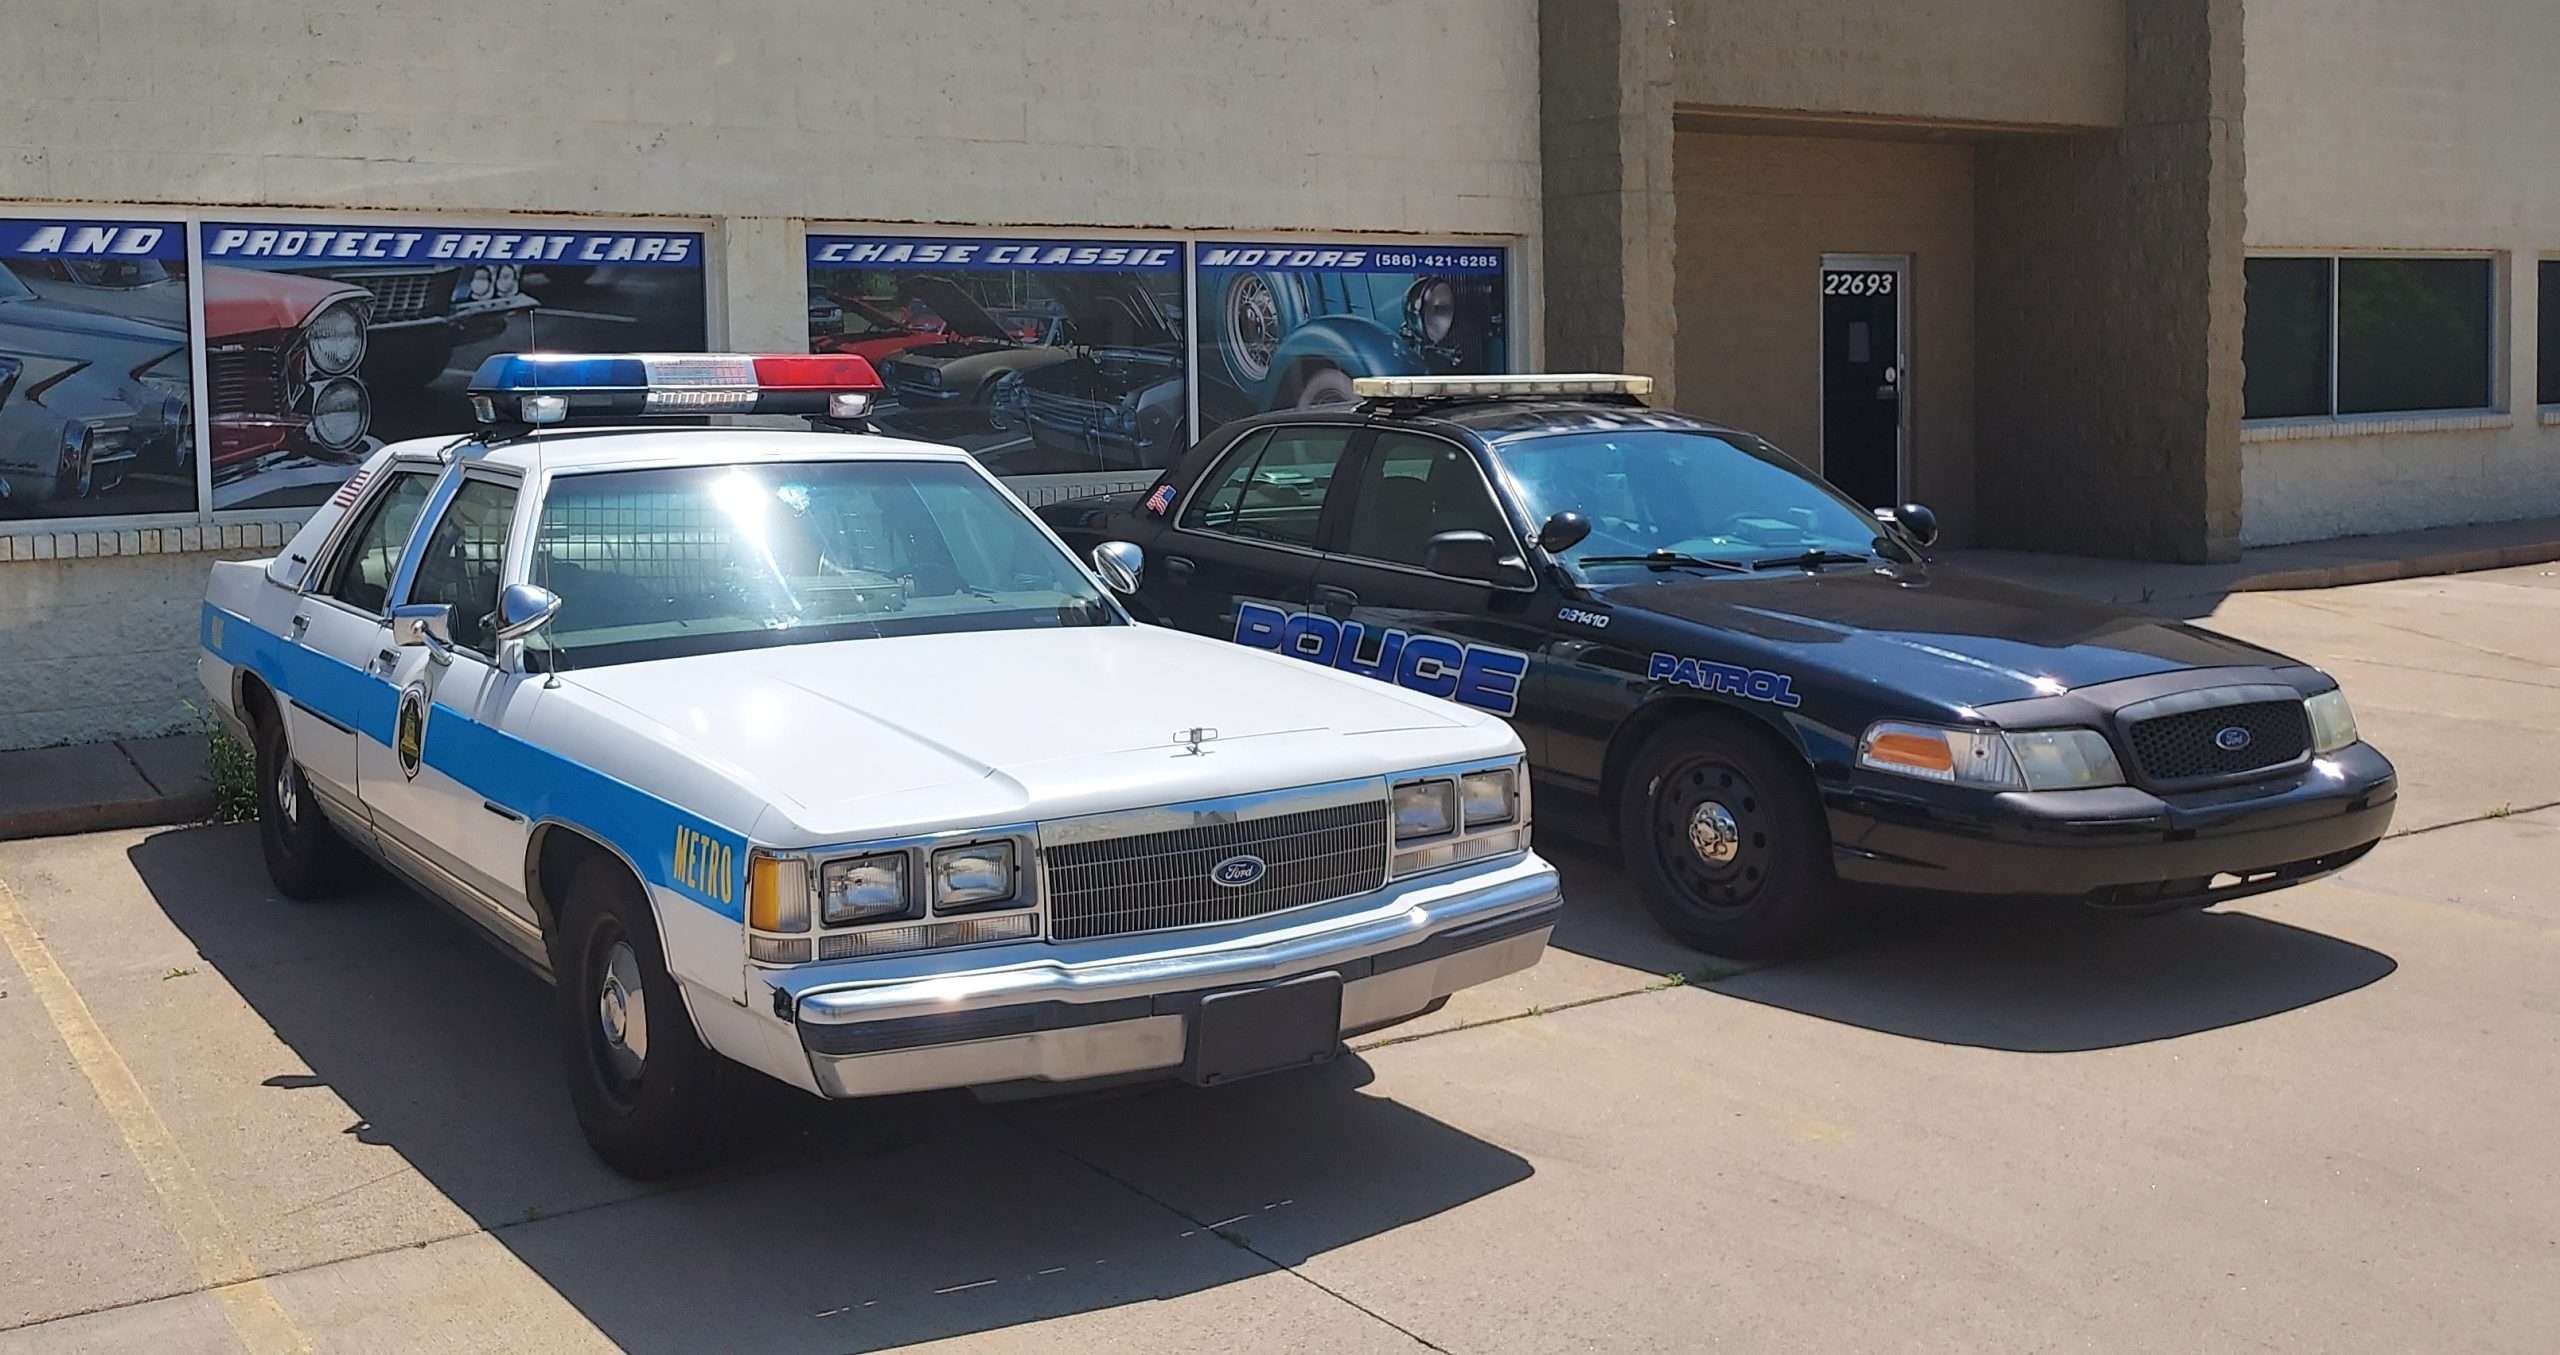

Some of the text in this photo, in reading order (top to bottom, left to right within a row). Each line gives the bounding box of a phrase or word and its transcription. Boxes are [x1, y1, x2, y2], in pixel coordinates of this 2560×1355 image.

[17, 226, 163, 254] AND
[208, 229, 691, 261] PROTECT GREAT CARS
[814, 243, 1175, 266] CHASE CLASSIC
[1201, 249, 1367, 267] MOTORS
[1824, 273, 1893, 296] 22693
[1233, 601, 1529, 717] POLICE
[1648, 652, 1801, 708] PATROL
[673, 825, 732, 904] METRO
[1225, 863, 1254, 880] Ford
